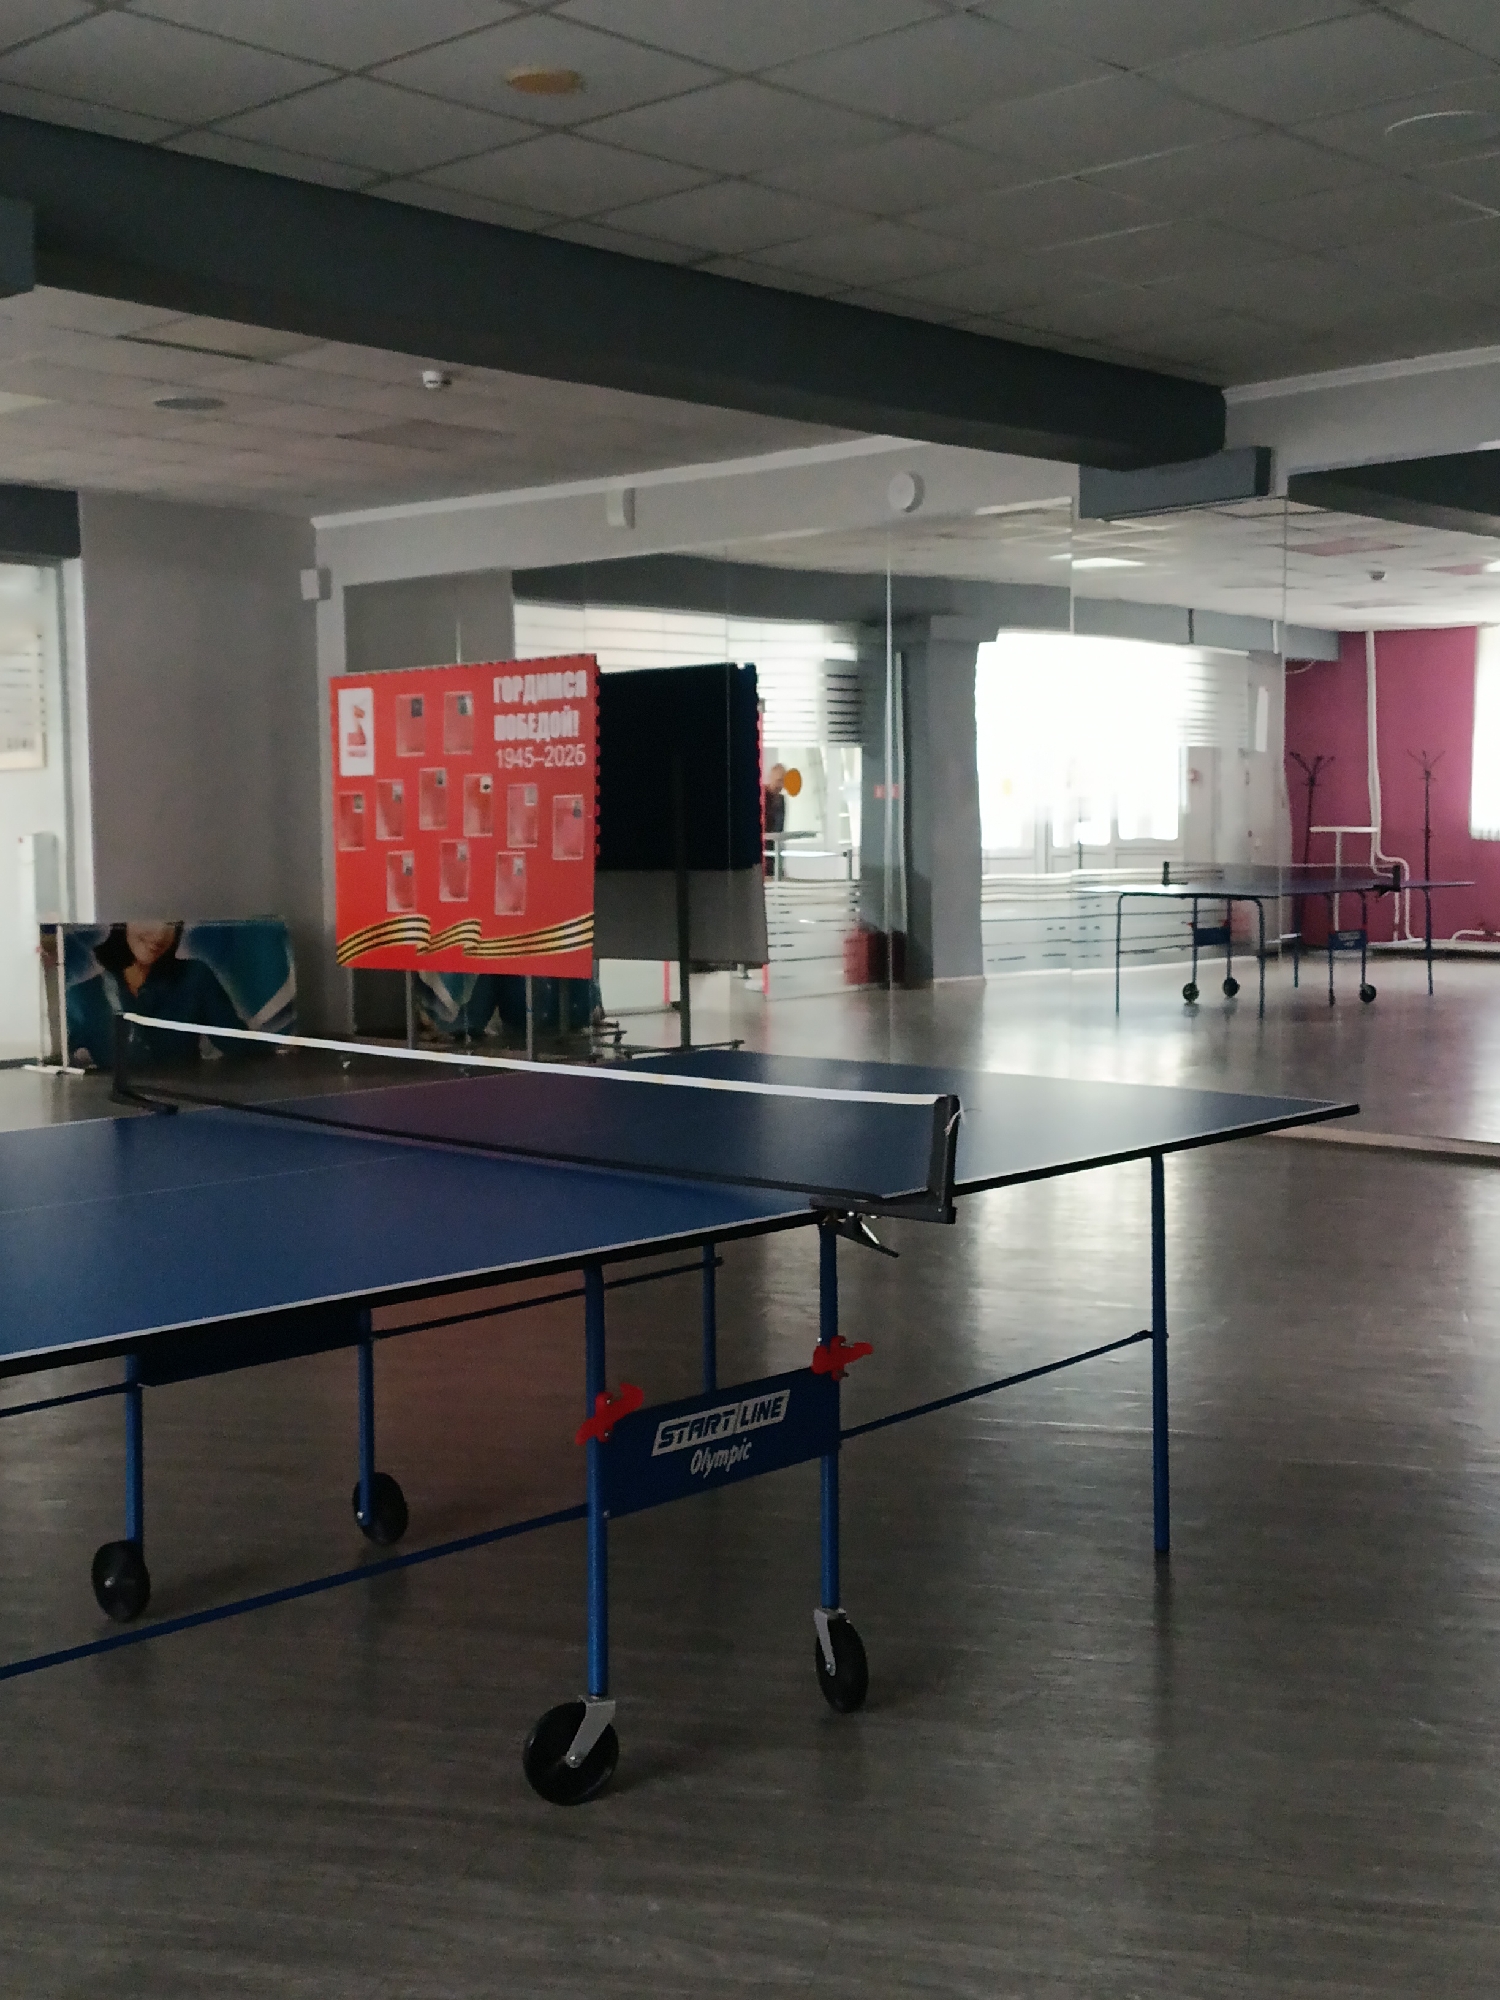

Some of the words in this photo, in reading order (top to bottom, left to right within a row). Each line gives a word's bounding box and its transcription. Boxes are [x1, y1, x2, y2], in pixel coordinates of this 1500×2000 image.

[657, 1408, 736, 1449] START
[739, 1396, 785, 1427] LINE
[690, 1438, 751, 1476] Olympic
